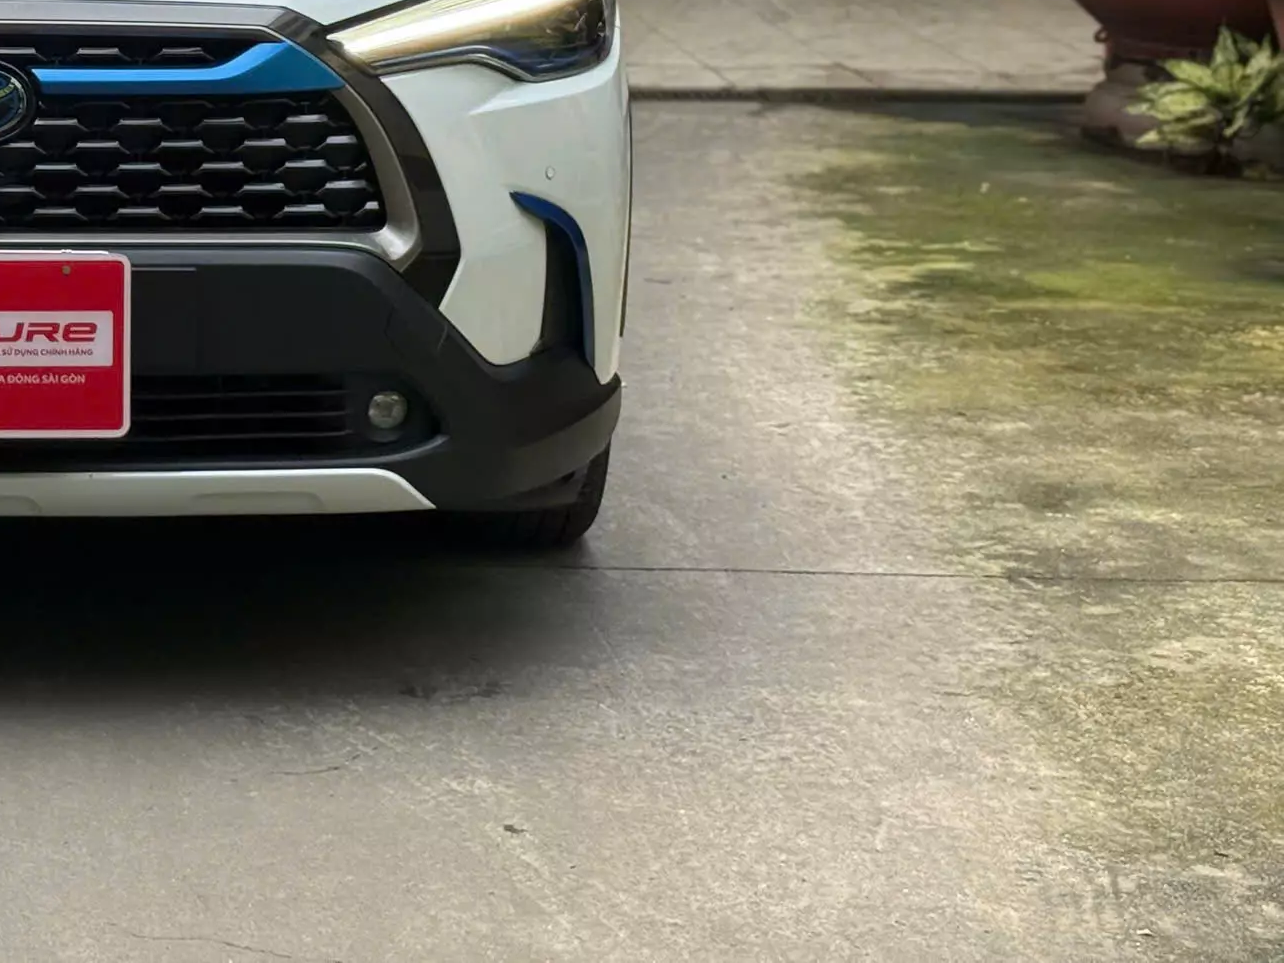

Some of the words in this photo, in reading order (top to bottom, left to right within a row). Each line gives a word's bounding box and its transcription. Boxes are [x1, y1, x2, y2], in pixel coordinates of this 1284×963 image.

[7, 372, 40, 384] ĐÔNG
[41, 372, 59, 384] SÀI
[60, 372, 86, 384] GÒN
